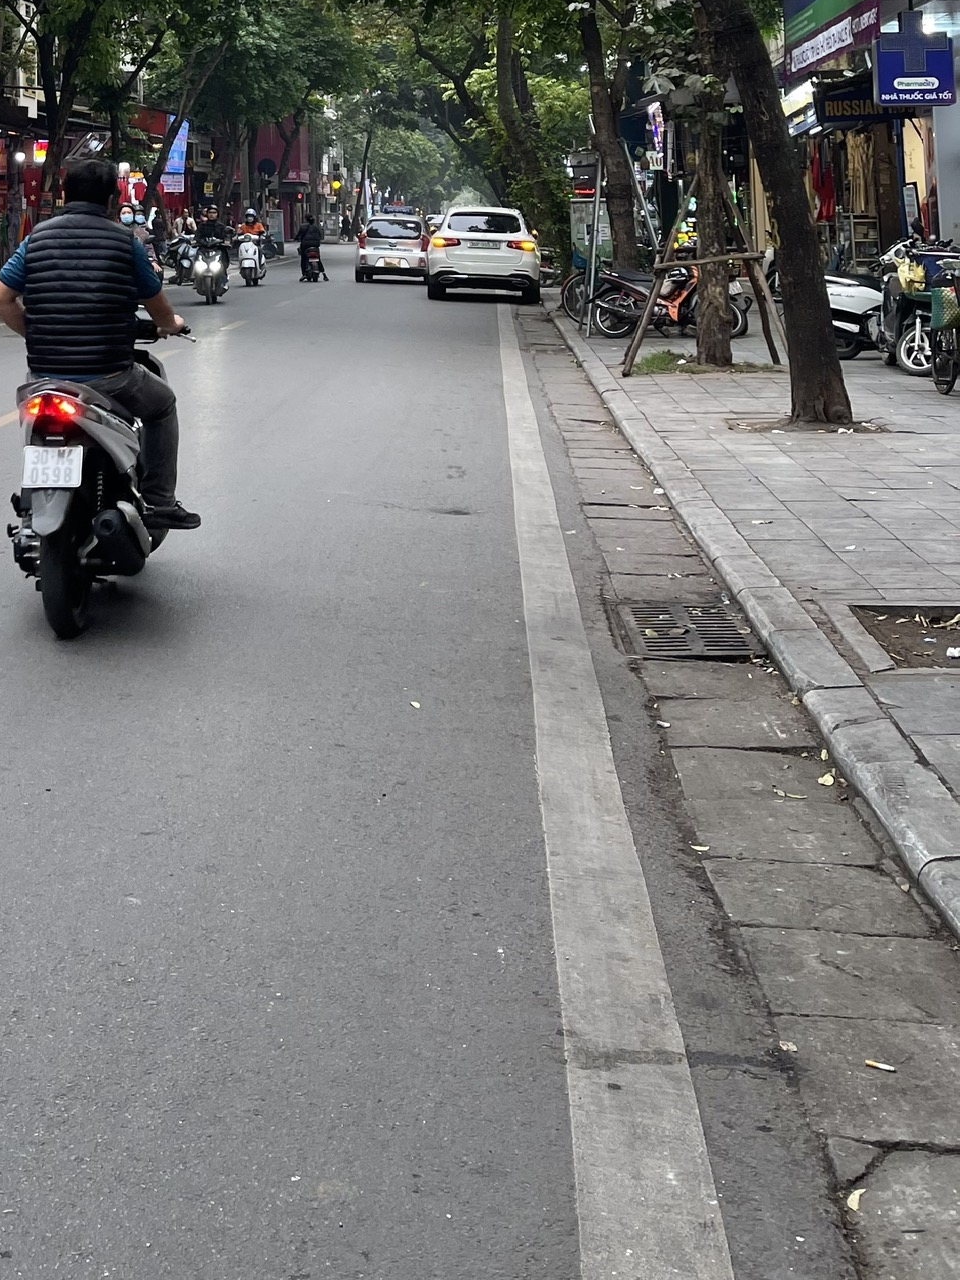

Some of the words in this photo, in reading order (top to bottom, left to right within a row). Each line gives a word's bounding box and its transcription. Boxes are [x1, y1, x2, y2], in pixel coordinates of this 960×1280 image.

[897, 78, 935, 88] Pharmacity
[899, 90, 923, 100] THUỐC
[824, 101, 884, 117] RUSSIAN
[30, 466, 73, 485] 0598
